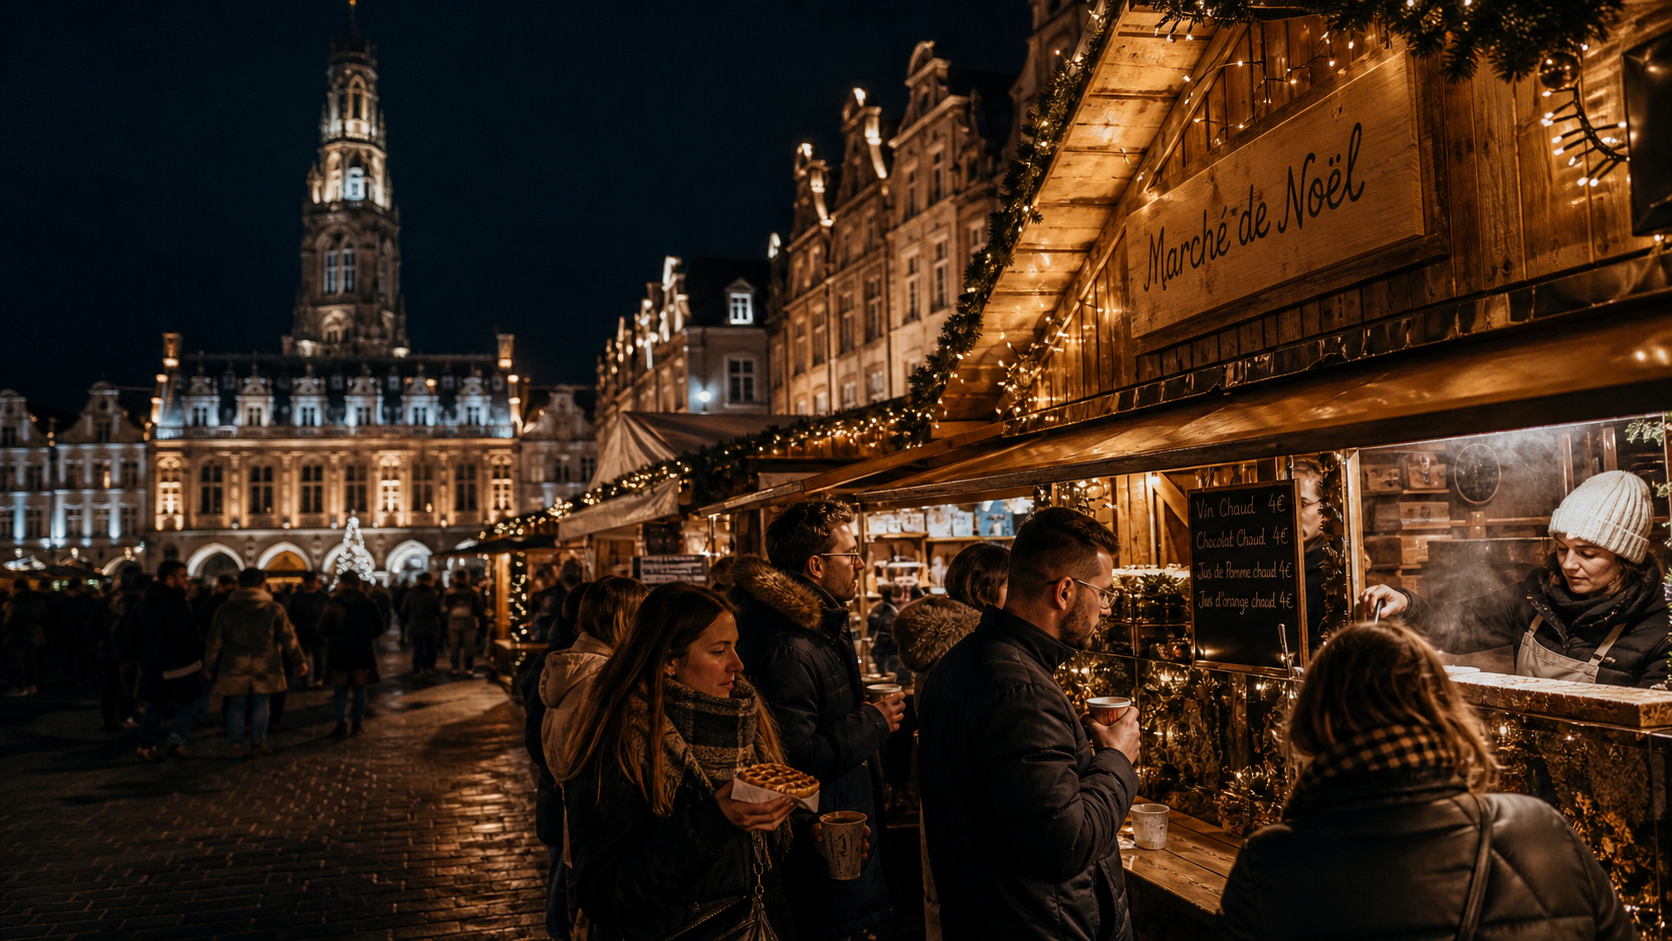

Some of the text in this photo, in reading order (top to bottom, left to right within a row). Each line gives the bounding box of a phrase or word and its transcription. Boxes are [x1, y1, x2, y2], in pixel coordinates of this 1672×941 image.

[1143, 122, 1365, 292] Marché de Noël
[1196, 493, 1286, 519] Vin Chaud 4€
[1196, 525, 1289, 549] Chocolat Chaud 4€
[1197, 560, 1293, 580] Jus de Pomme chaud 4€
[1198, 590, 1294, 616] Jus d'orange chaud 4€
